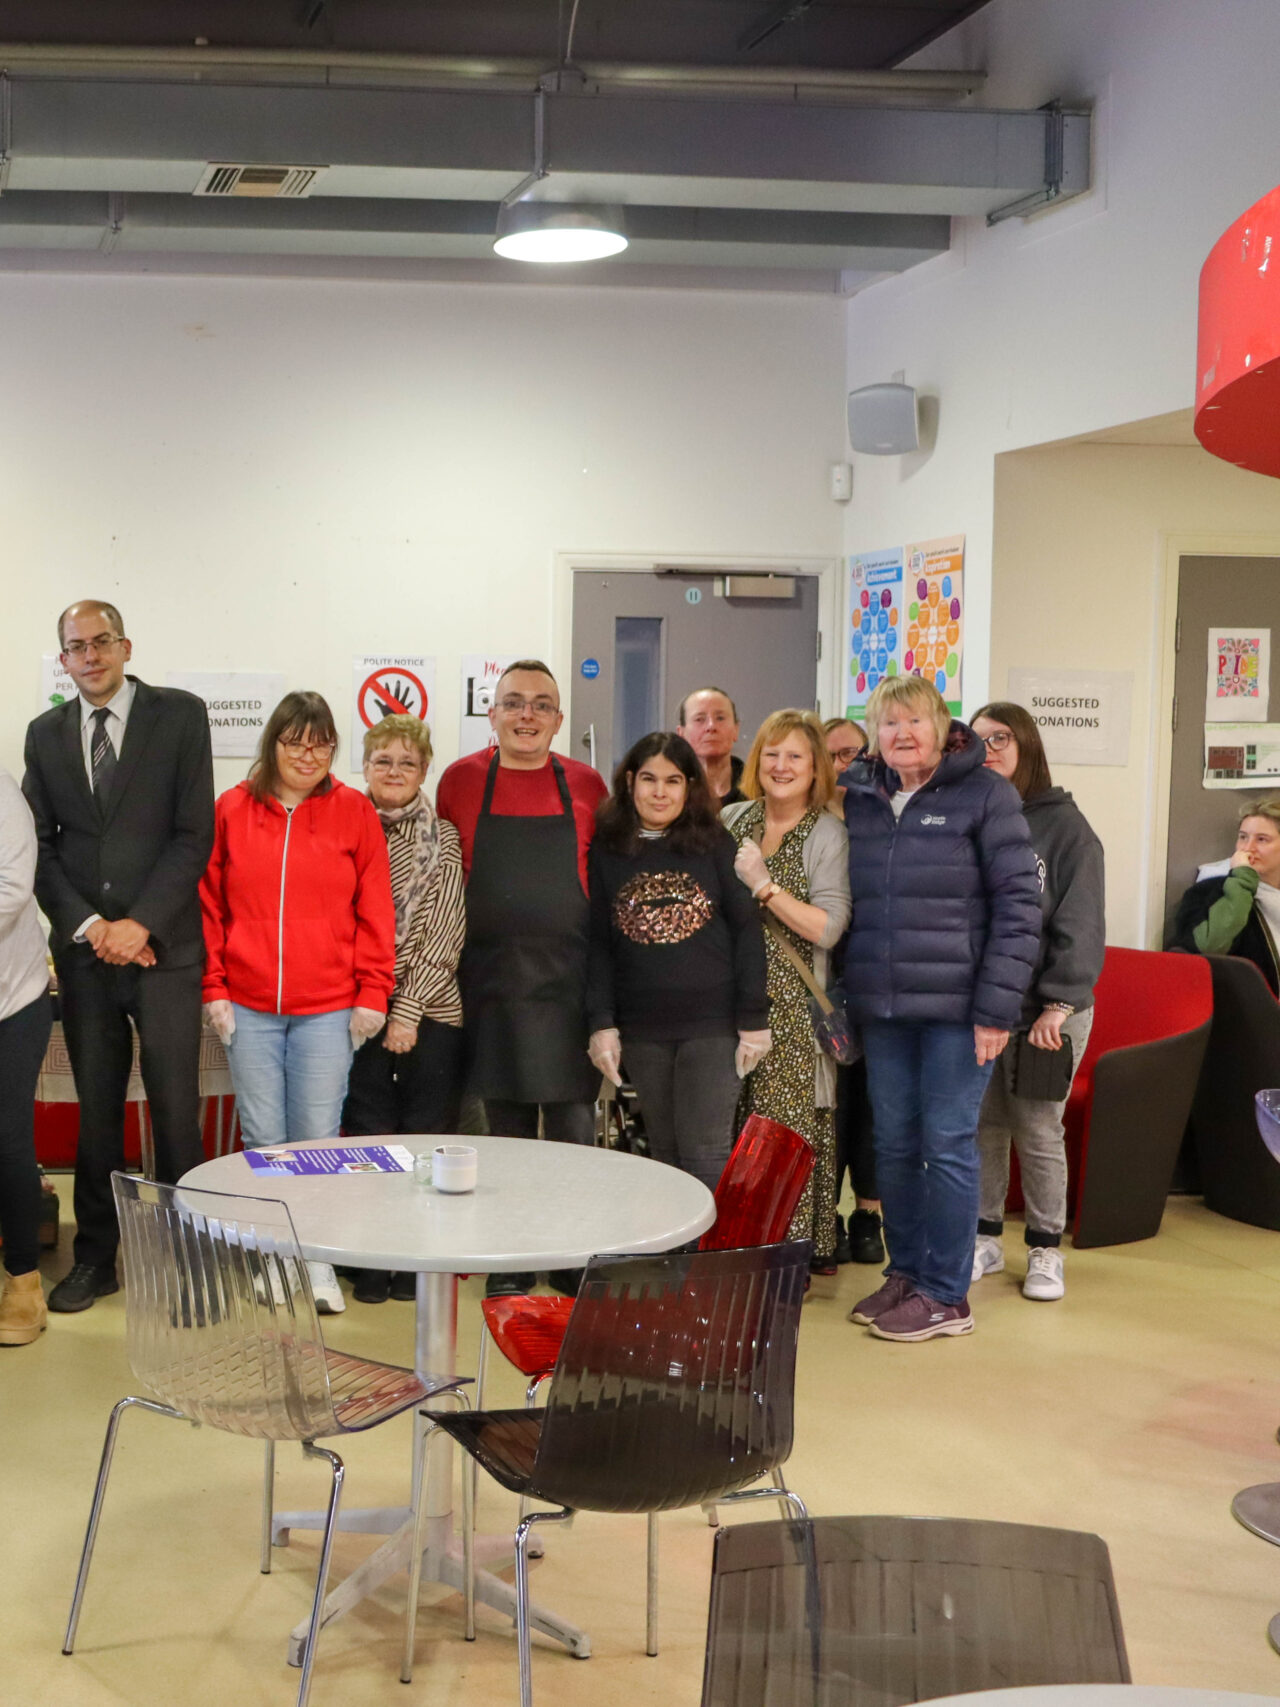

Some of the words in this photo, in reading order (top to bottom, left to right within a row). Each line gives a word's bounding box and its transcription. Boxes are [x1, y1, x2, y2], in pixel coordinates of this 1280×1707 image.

[1218, 654, 1259, 678] PRIDE
[204, 700, 262, 710] UGGESTED
[1031, 696, 1100, 709] SUGGESTED
[207, 718, 263, 727] ONATIONS
